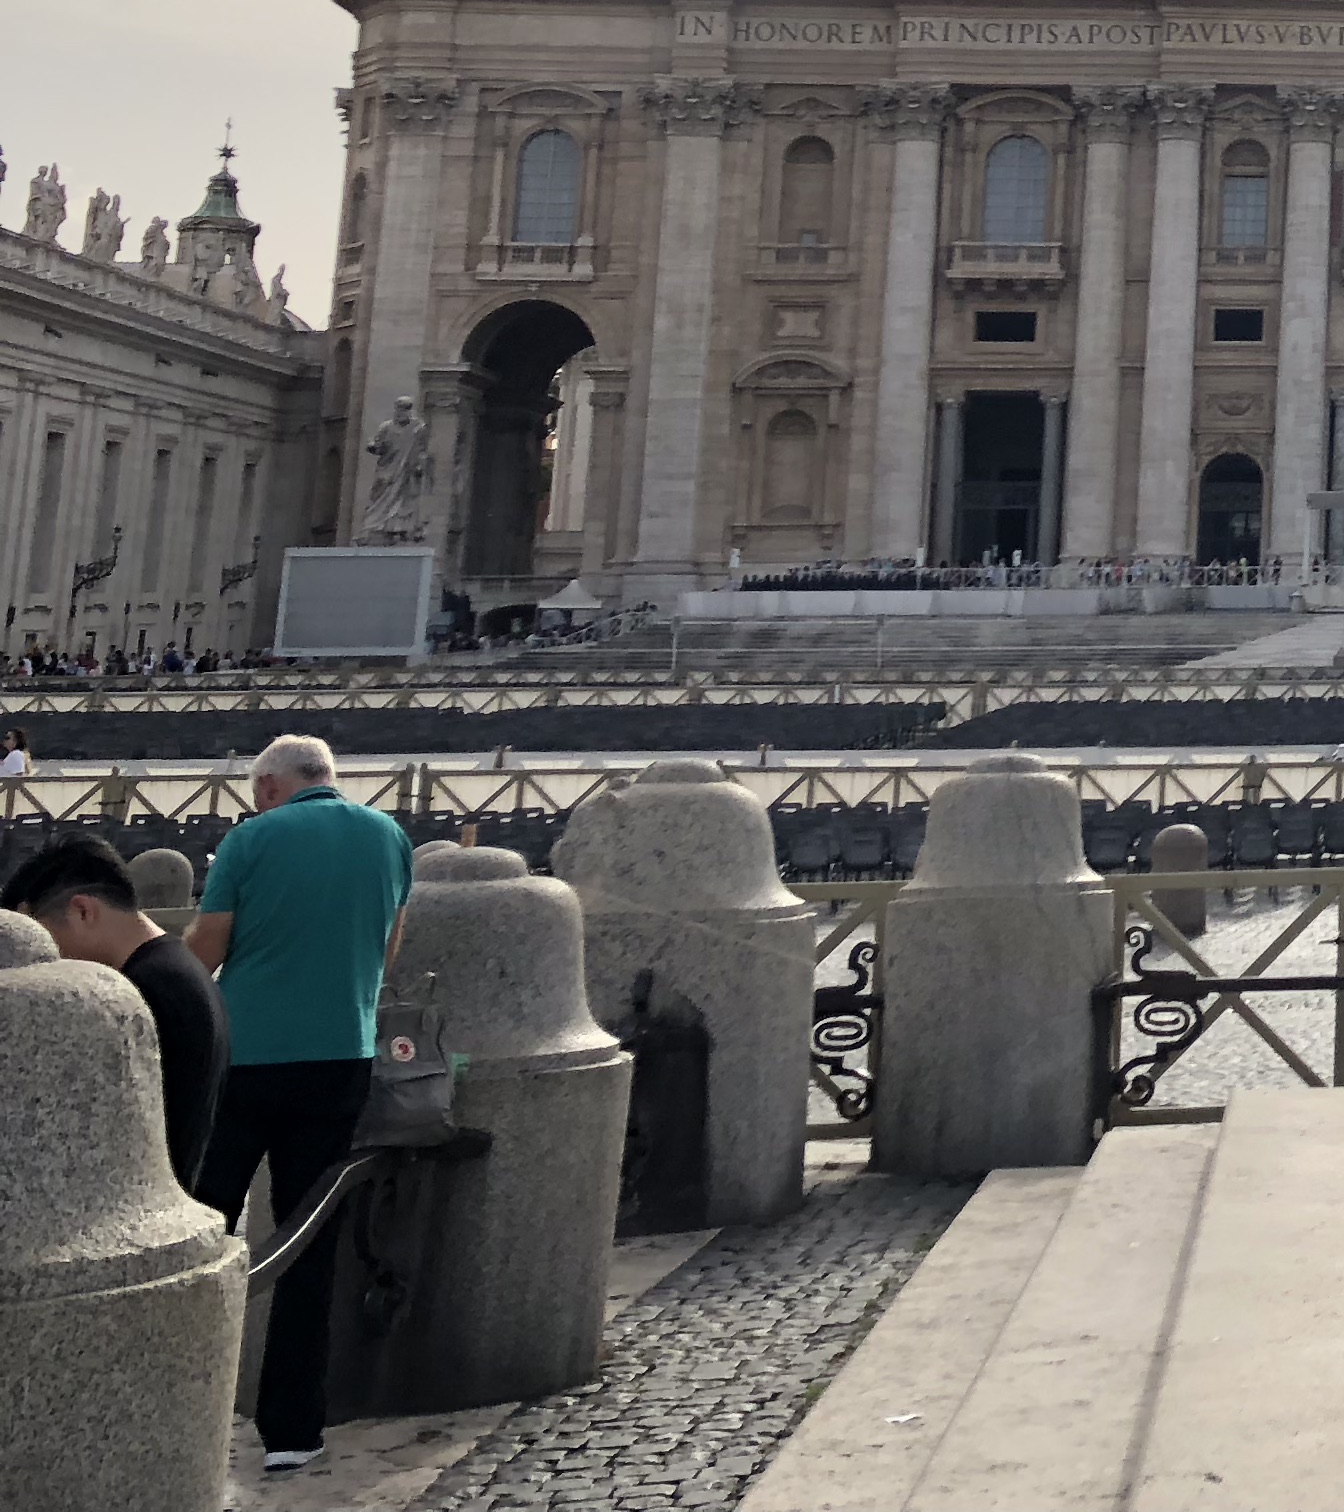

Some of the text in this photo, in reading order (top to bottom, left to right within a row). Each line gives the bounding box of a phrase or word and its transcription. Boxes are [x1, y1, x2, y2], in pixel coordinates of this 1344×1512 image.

[733, 21, 892, 45] HONOREM
[902, 21, 1059, 44] PRINCIPIS
[1165, 22, 1266, 44] PAVLVS
